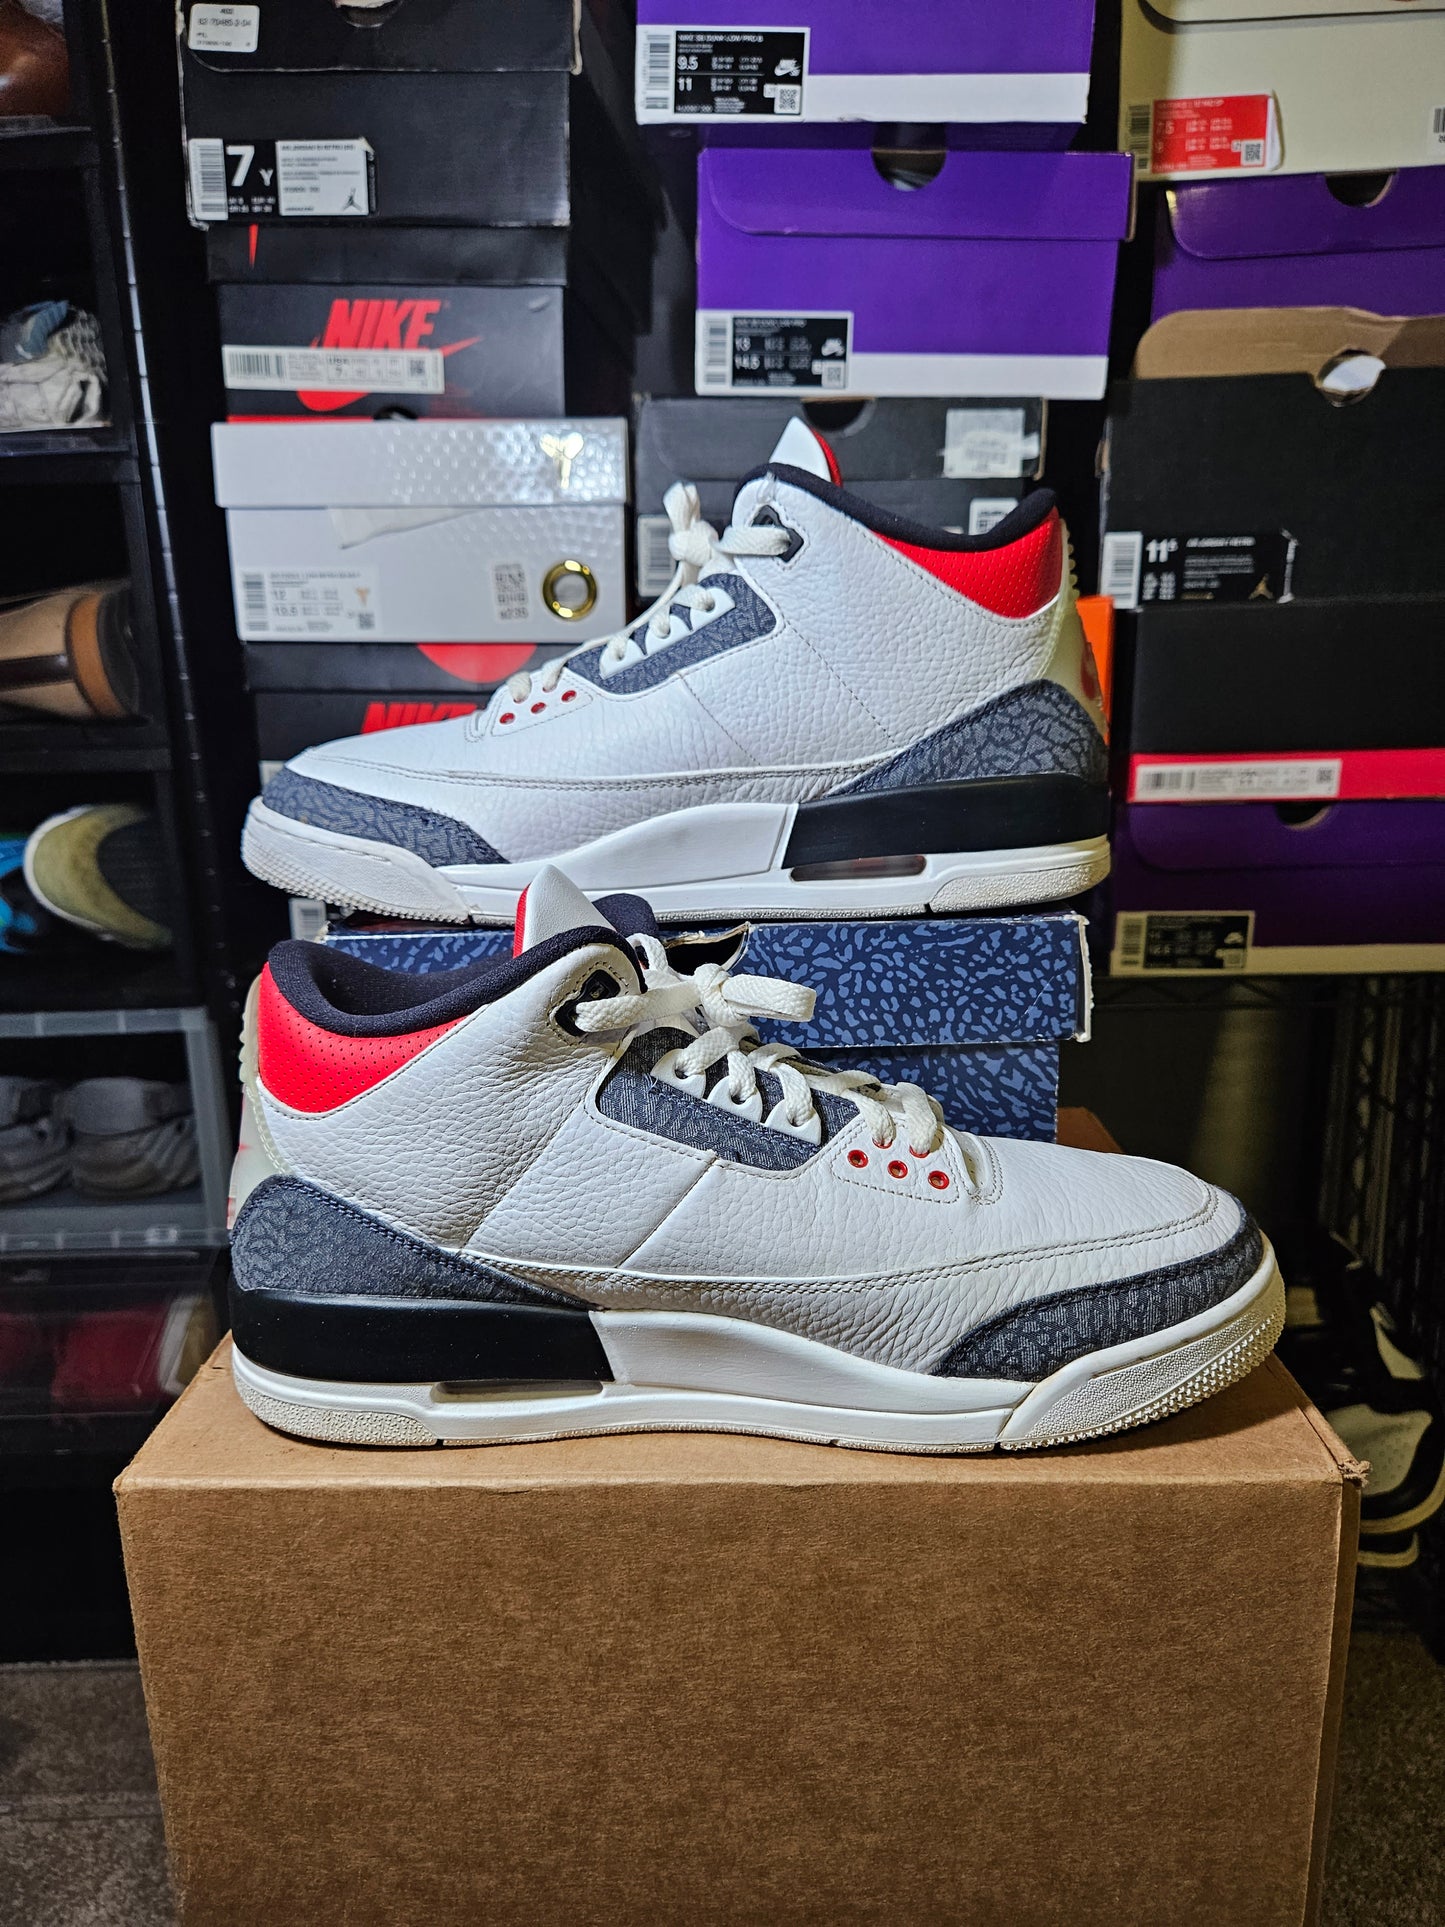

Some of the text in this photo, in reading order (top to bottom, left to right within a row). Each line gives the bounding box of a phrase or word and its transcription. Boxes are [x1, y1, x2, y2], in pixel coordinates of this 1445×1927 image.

[677, 55, 699, 71] 9.5
[677, 76, 693, 92] 11
[226, 145, 274, 187] 7 Y
[322, 299, 442, 351] NIKE
[361, 702, 477, 735] NI
